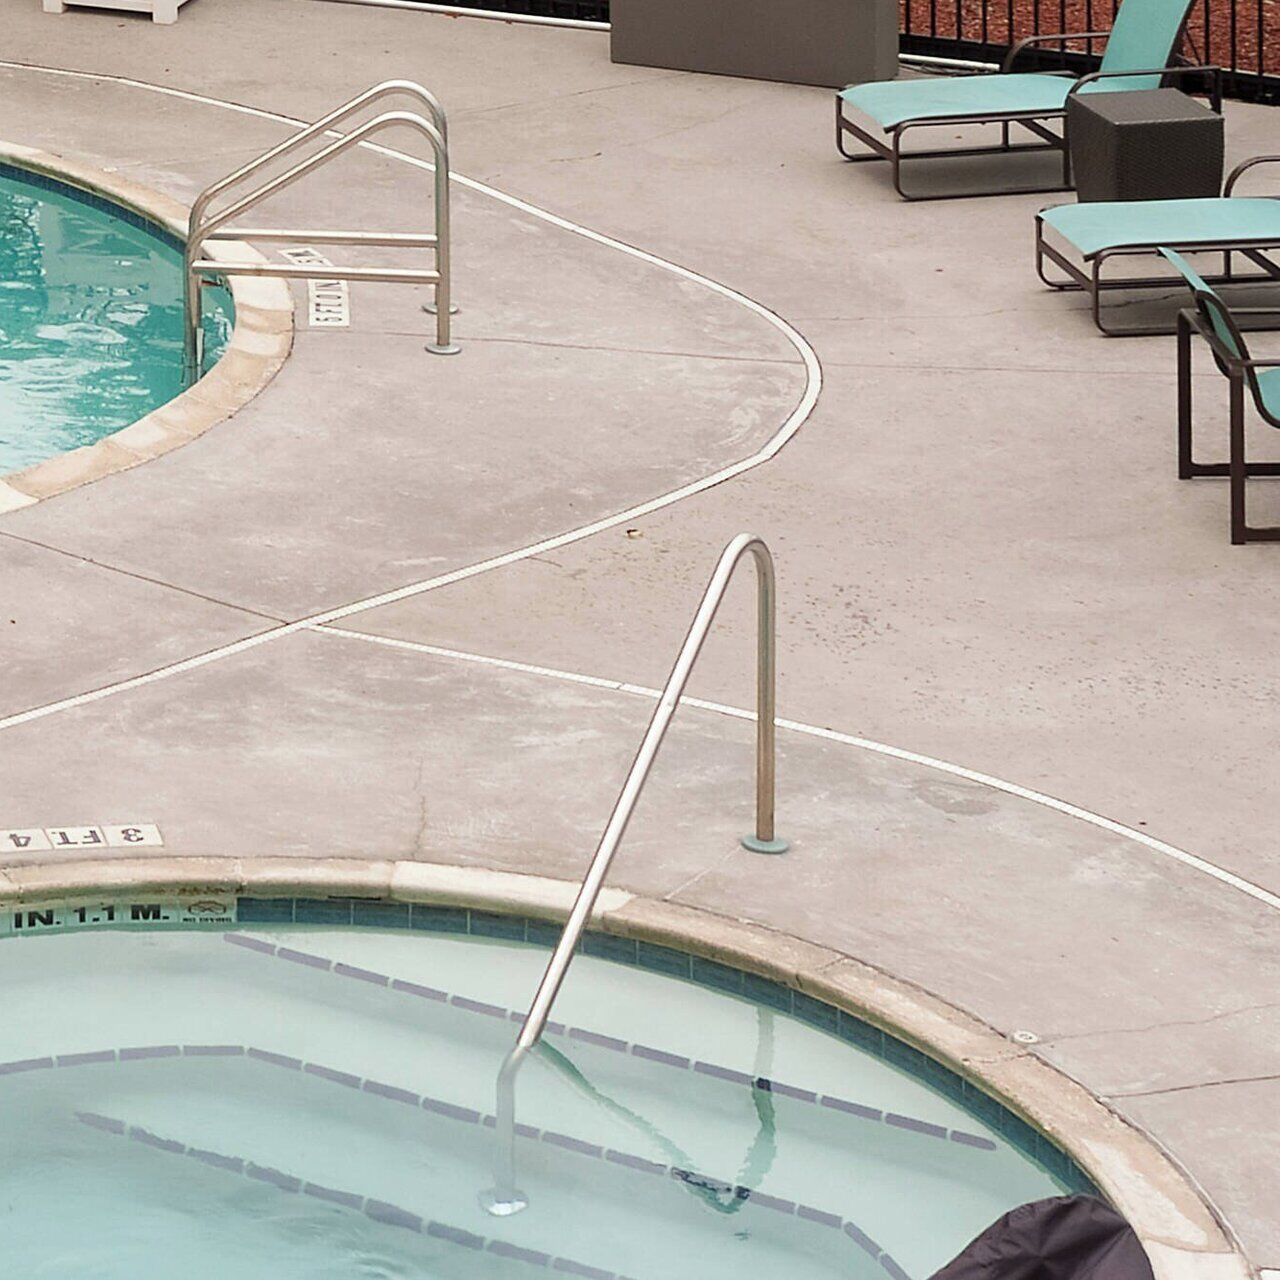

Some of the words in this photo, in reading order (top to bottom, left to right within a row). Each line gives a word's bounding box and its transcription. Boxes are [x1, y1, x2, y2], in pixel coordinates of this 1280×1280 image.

[9, 833, 31, 847] 4
[121, 828, 144, 842] 3
[14, 909, 62, 929] IN.
[73, 905, 115, 923] 1.1
[130, 904, 170, 921] M.
